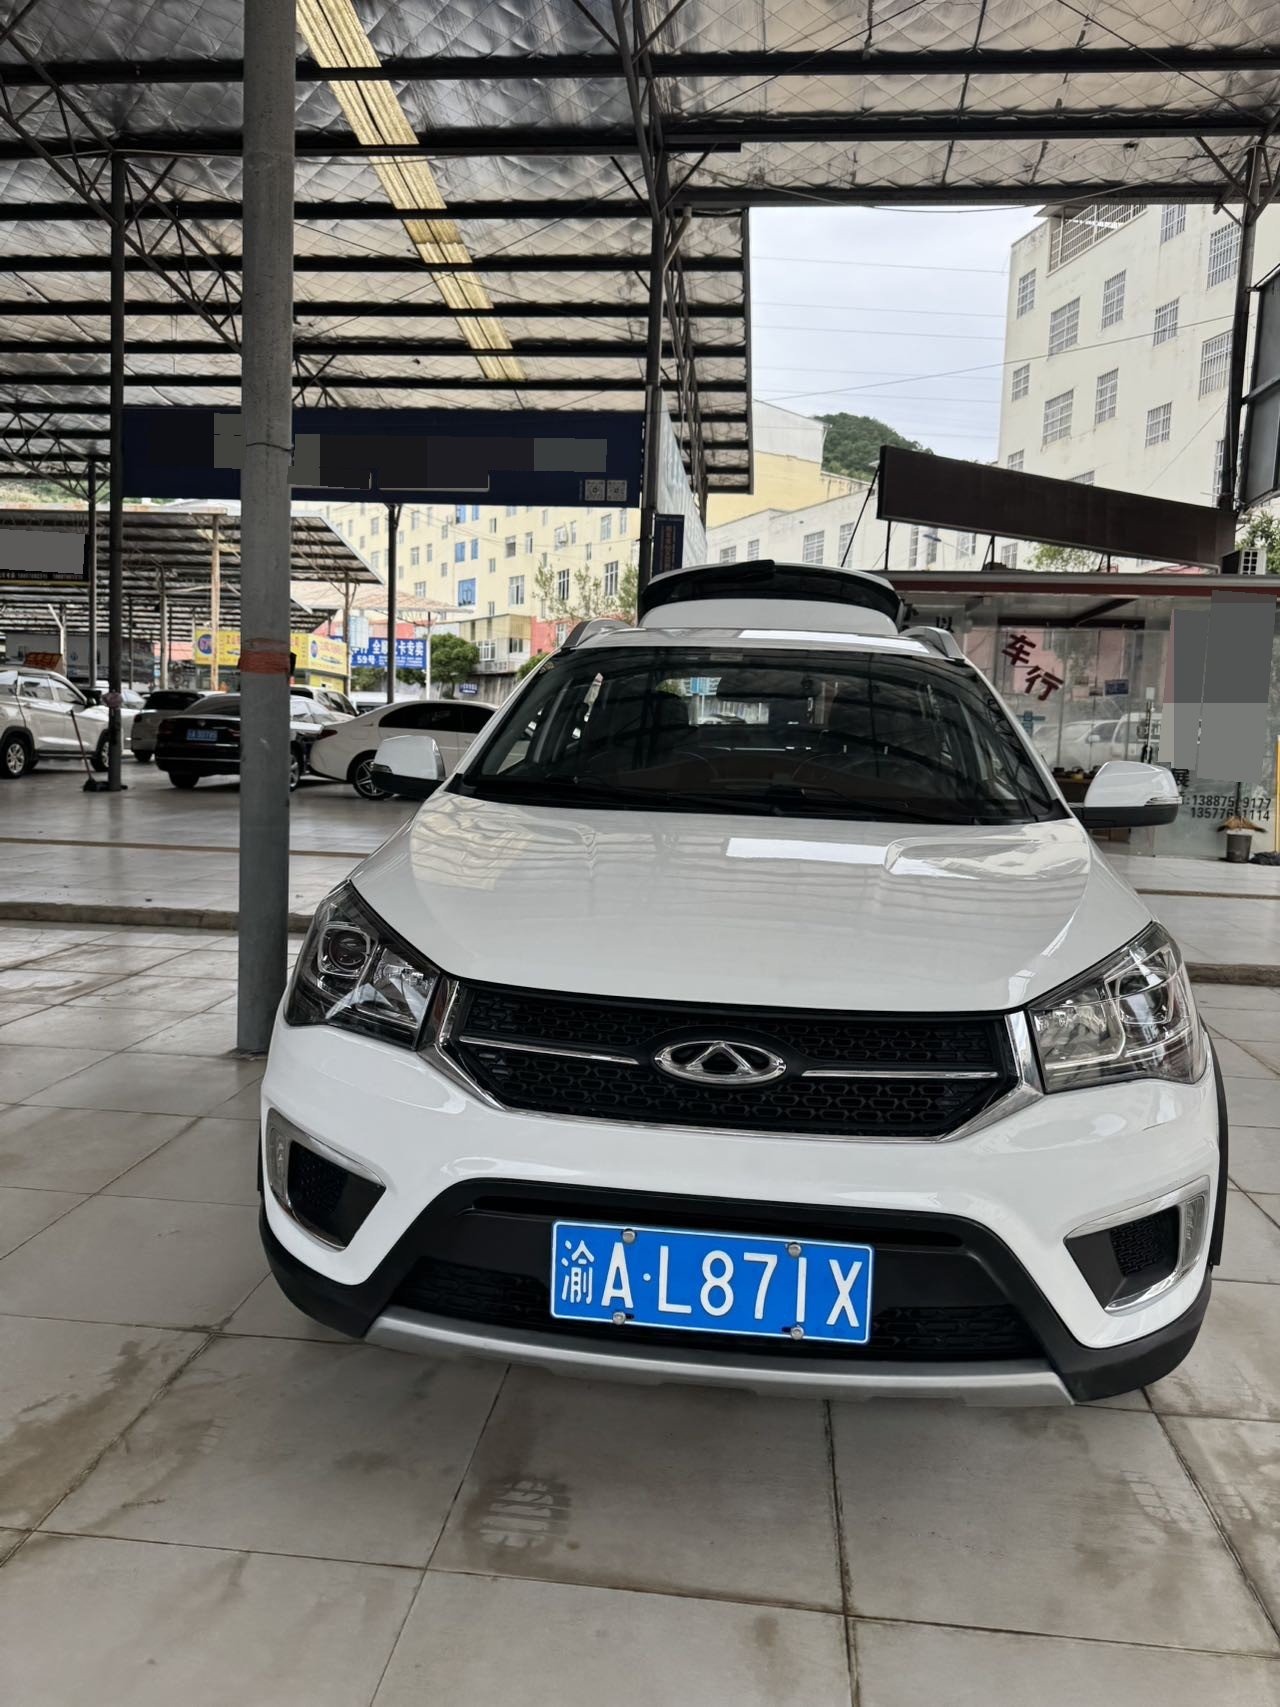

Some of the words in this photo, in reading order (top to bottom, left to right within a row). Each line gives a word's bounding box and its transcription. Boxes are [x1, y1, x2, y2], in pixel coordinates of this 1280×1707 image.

[1001, 633, 1065, 701] 车行
[1190, 806, 1271, 821] 1357761114
[561, 1239, 863, 1328] 渝A·L871X
